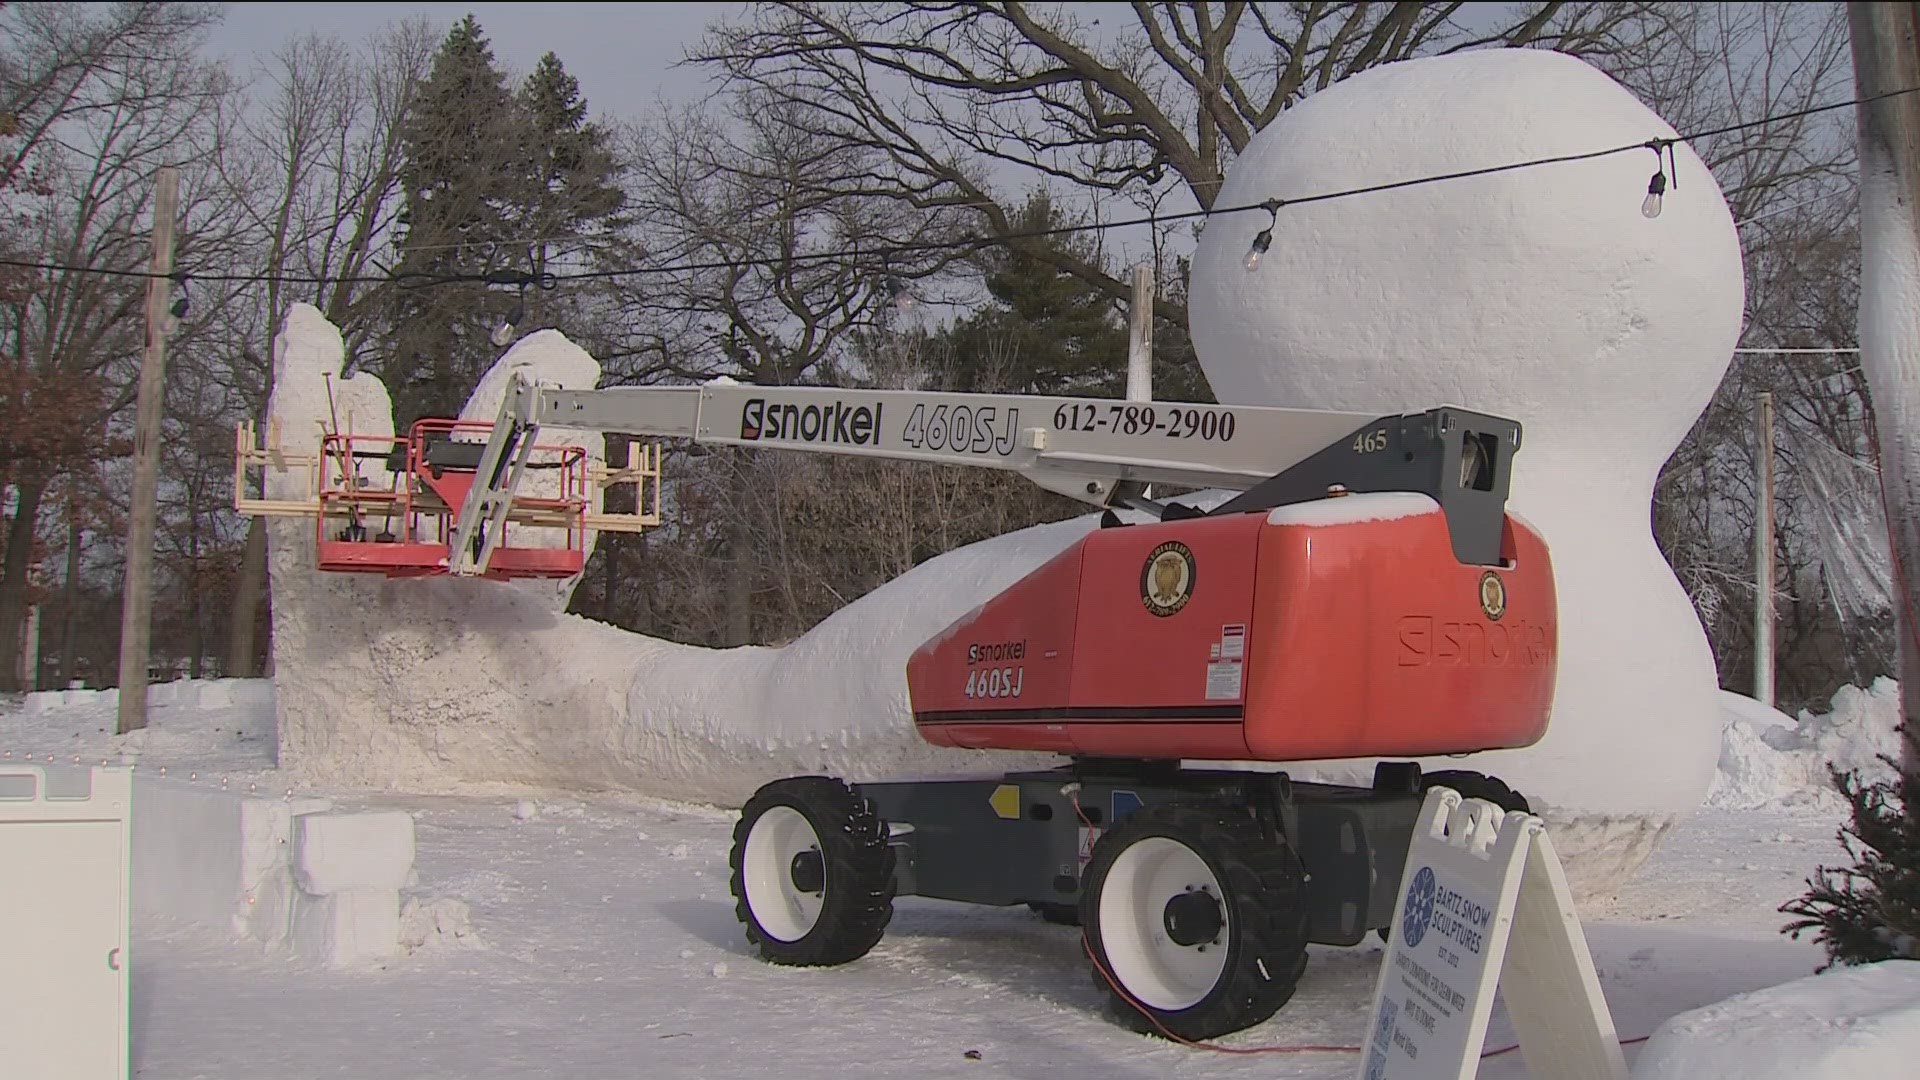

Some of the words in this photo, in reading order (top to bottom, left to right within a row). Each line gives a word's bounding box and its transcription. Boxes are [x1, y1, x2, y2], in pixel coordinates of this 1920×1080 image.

[765, 401, 882, 445] snorkel
[903, 403, 1019, 456] 460SJ
[1053, 403, 1236, 442] 612-789-2900
[1353, 429, 1387, 454] 465
[978, 639, 1026, 662] snorkel
[964, 666, 1024, 699] 460SJ
[1436, 887, 1462, 914] BARTZ
[1462, 901, 1491, 928] SNOW
[1432, 911, 1482, 954] SCULPTURES
